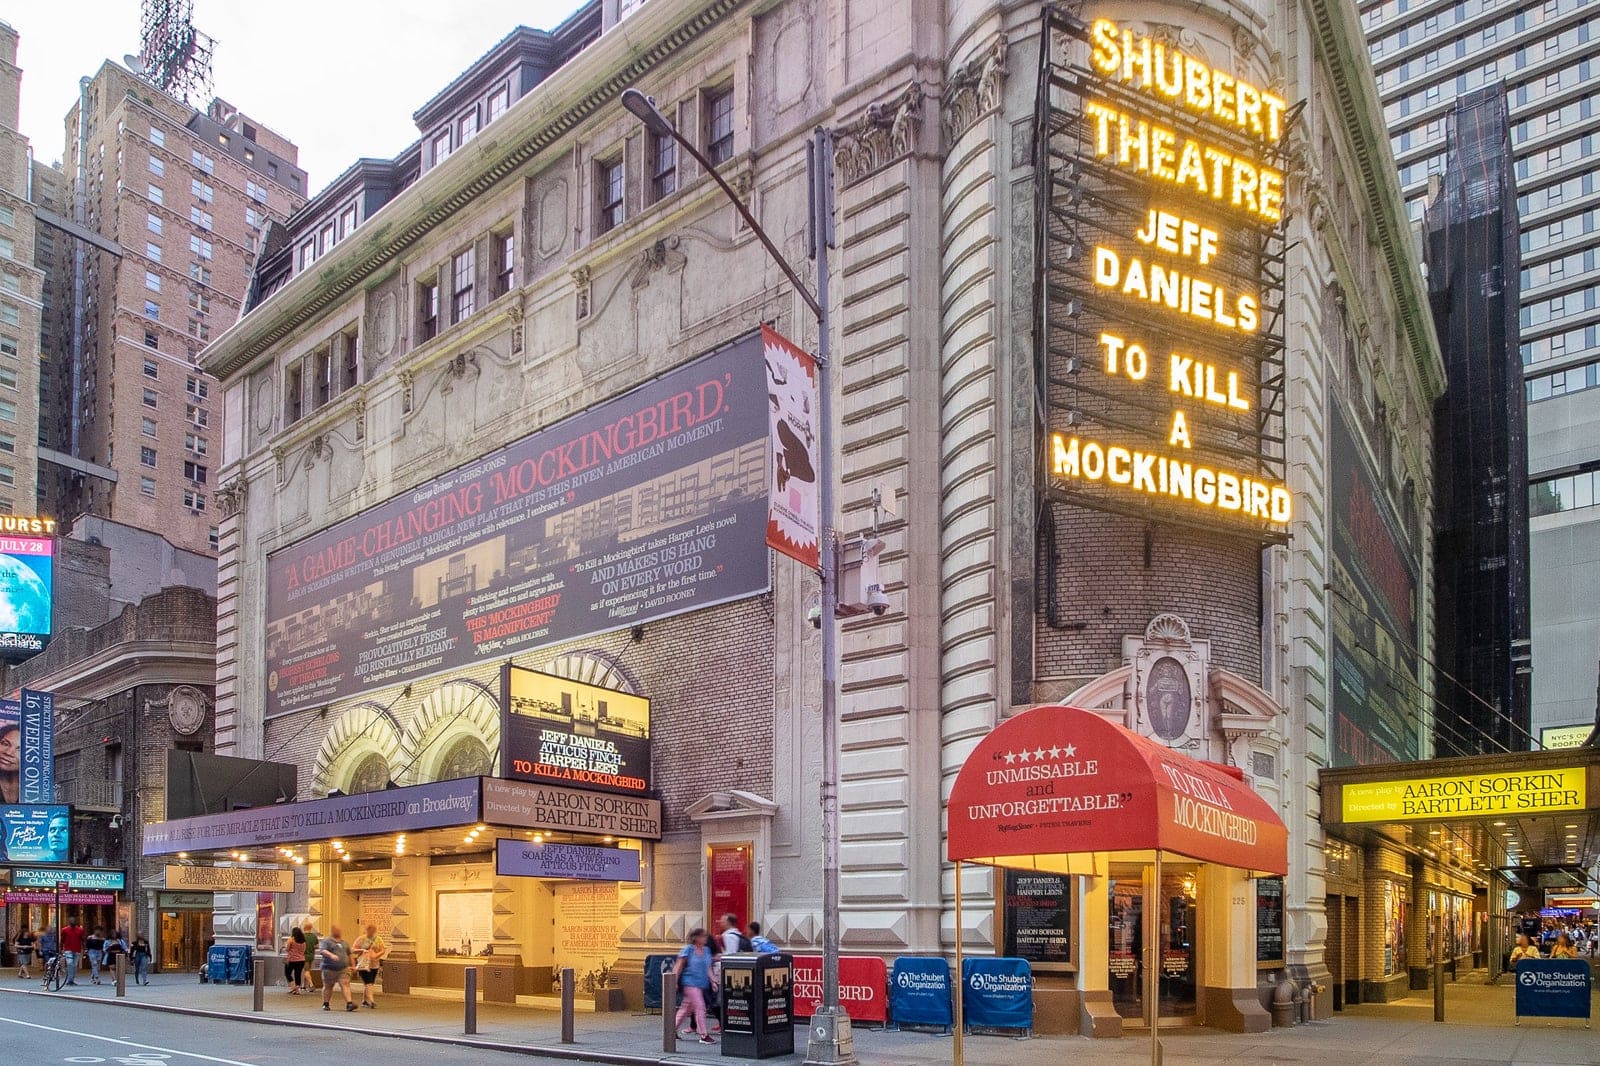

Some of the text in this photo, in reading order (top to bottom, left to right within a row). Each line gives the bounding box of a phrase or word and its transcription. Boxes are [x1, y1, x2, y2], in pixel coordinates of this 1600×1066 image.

[1091, 18, 1287, 142] SHUBERT
[1087, 102, 1282, 221] THEATRE
[1137, 210, 1218, 264] JEFF
[1095, 246, 1258, 332] DANIELS
[1100, 333, 1249, 410] TO KILL
[1168, 411, 1191, 449] A
[460, 456, 507, 483] CHRIS JONES
[1053, 435, 1292, 523] MOCKINGBIRD
[422, 525, 456, 548] RADICAL
[457, 518, 476, 534] NEW
[477, 507, 499, 526] PLAY
[500, 499, 524, 516] THAT
[525, 489, 546, 507] FITS
[547, 480, 570, 499] THIS
[572, 466, 604, 489] RIVEN
[606, 441, 666, 476] AMERICAN
[667, 418, 725, 450] MOMENT.
[531, 500, 557, 516] embrace
[303, 482, 484, 582] GAME-CHANGING
[585, 556, 597, 569] Kill
[648, 537, 667, 550] takes
[668, 529, 695, 544] Harper
[696, 521, 715, 535] Lee's
[716, 514, 737, 529] novel
[30, 542, 43, 552] 28
[590, 534, 717, 585] AND MAKES US HANG
[498, 572, 554, 597] and with
[602, 555, 703, 595] ON EVERY WORD
[517, 591, 528, 601] and
[529, 586, 547, 598] argue
[590, 602, 599, 611] as
[599, 598, 605, 609] if
[605, 587, 649, 608] experiencing
[656, 582, 667, 593] for
[668, 577, 680, 589] the
[681, 572, 697, 586] first
[645, 588, 697, 609] DAVID ROONEY
[466, 615, 487, 632] THIS
[359, 635, 419, 663] PROVOCATIVELY
[419, 627, 447, 645] FRESH
[473, 630, 483, 644] IS
[353, 663, 369, 677] AND
[370, 650, 415, 672] RUSTICALLY
[43, 696, 51, 732] STRICTLY
[25, 694, 40, 804] 16 WEEKS ONLY
[539, 730, 615, 752] JEFF DANIELS
[1551, 733, 1574, 741] NYC'S
[539, 752, 619, 776] HARPER LEE'S
[540, 741, 622, 766] ATTICUS FINCH
[513, 760, 646, 790] TO KILL A MOCKINGBIRD
[986, 760, 1098, 786] UNMISSABLE
[1026, 781, 1055, 797] and
[1161, 763, 1233, 811] TO KILL A
[1376, 787, 1393, 797] play
[1394, 786, 1404, 795] by
[1403, 773, 1565, 800] AARON SORKIN
[486, 783, 650, 818] A new play by AARON SORKIN
[1349, 802, 1398, 813] Directed by
[1402, 790, 1580, 816] BARTLETT SHER
[211, 824, 225, 837] THE
[226, 821, 259, 836] MIRACLE
[259, 817, 281, 832] THAT
[281, 816, 290, 829] IS
[305, 811, 326, 827] KILL
[327, 811, 334, 824] A
[408, 803, 420, 815] on
[487, 801, 659, 835] Directed by BARTLETT SHER
[1174, 793, 1257, 846] MOCKINGBIRD
[521, 851, 621, 865] SOARS AS A TOWERING
[542, 844, 604, 856] JEFF DANIELS
[16, 871, 121, 881] BROADWAY'S ROMANTIC
[540, 861, 577, 871] ATTICUS
[29, 878, 64, 886] CLASS
[1232, 896, 1246, 905] 225
[793, 968, 824, 983] KILL
[908, 972, 945, 982] The Shubert
[908, 981, 946, 990] Organization
[984, 973, 1027, 983] The Shubert
[984, 982, 1027, 992] Organization
[1536, 972, 1586, 980] The Shubert
[1536, 979, 1586, 988] Organization
[793, 983, 874, 1001] CKINBIRD
